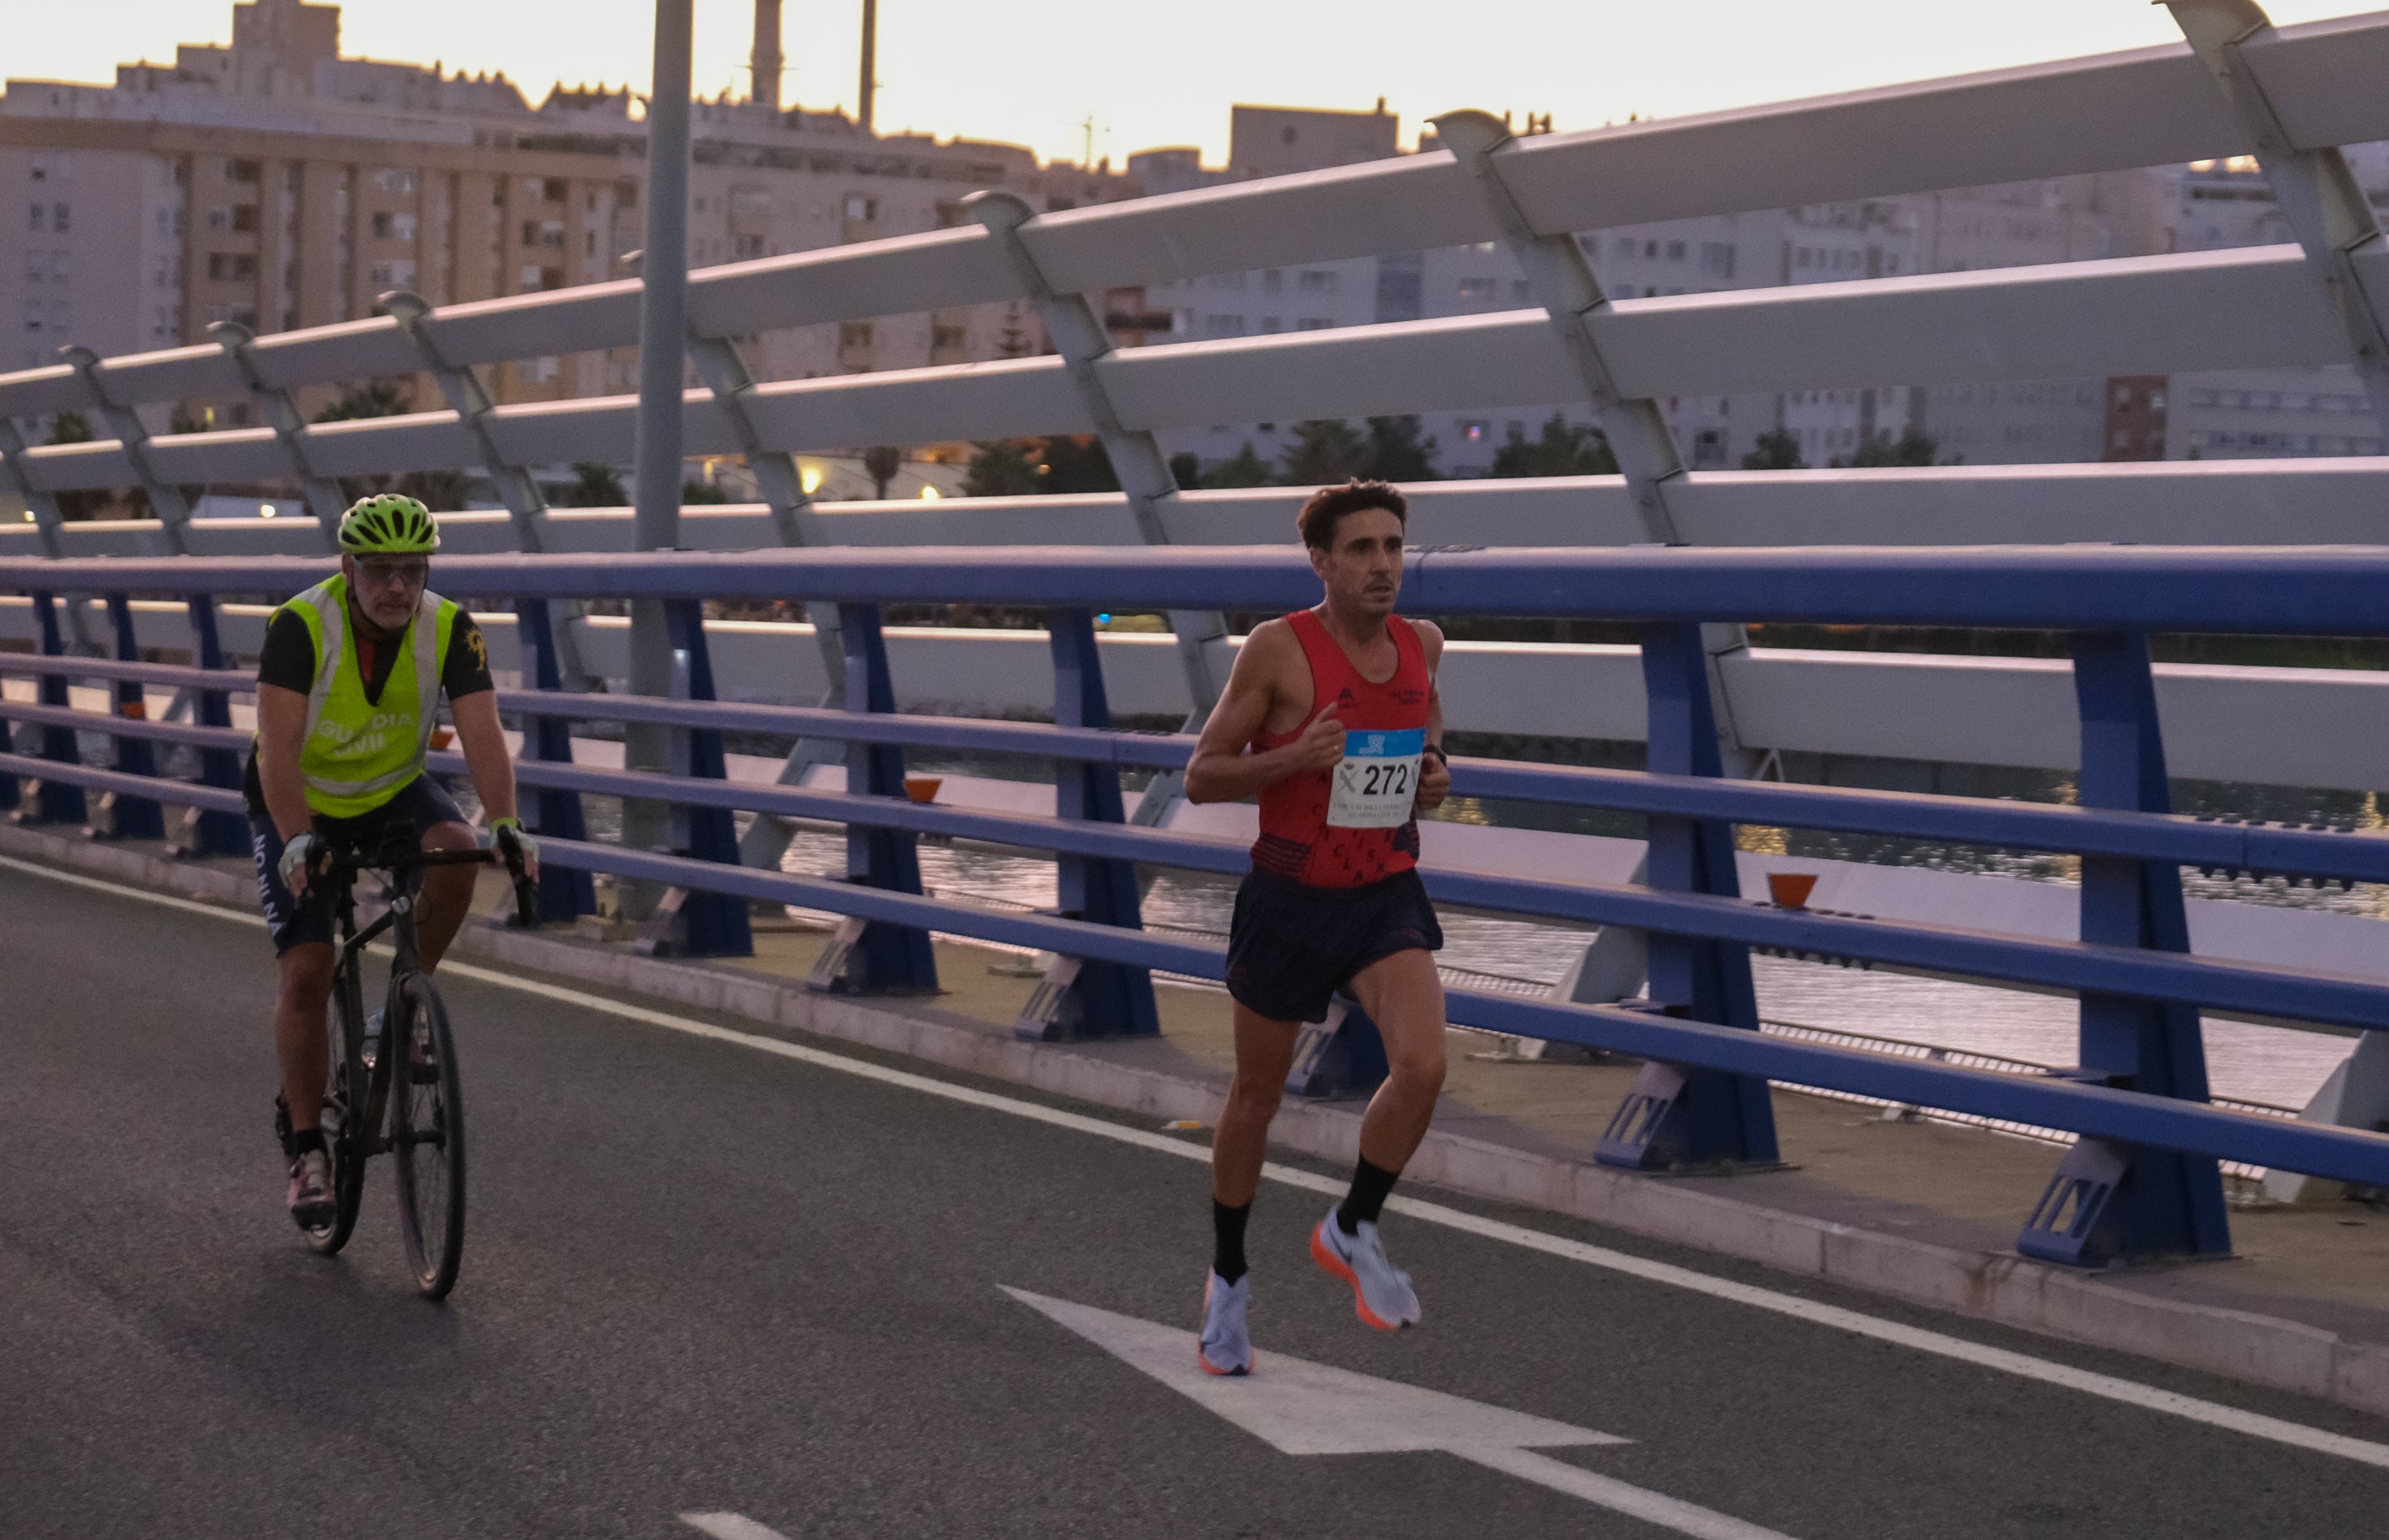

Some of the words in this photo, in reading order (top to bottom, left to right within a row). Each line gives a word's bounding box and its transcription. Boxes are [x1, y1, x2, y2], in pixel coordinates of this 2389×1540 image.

[318, 713, 413, 743] GUDIA
[1363, 763, 1408, 795] 272
[254, 833, 265, 869] NO
[258, 873, 271, 897] NI
